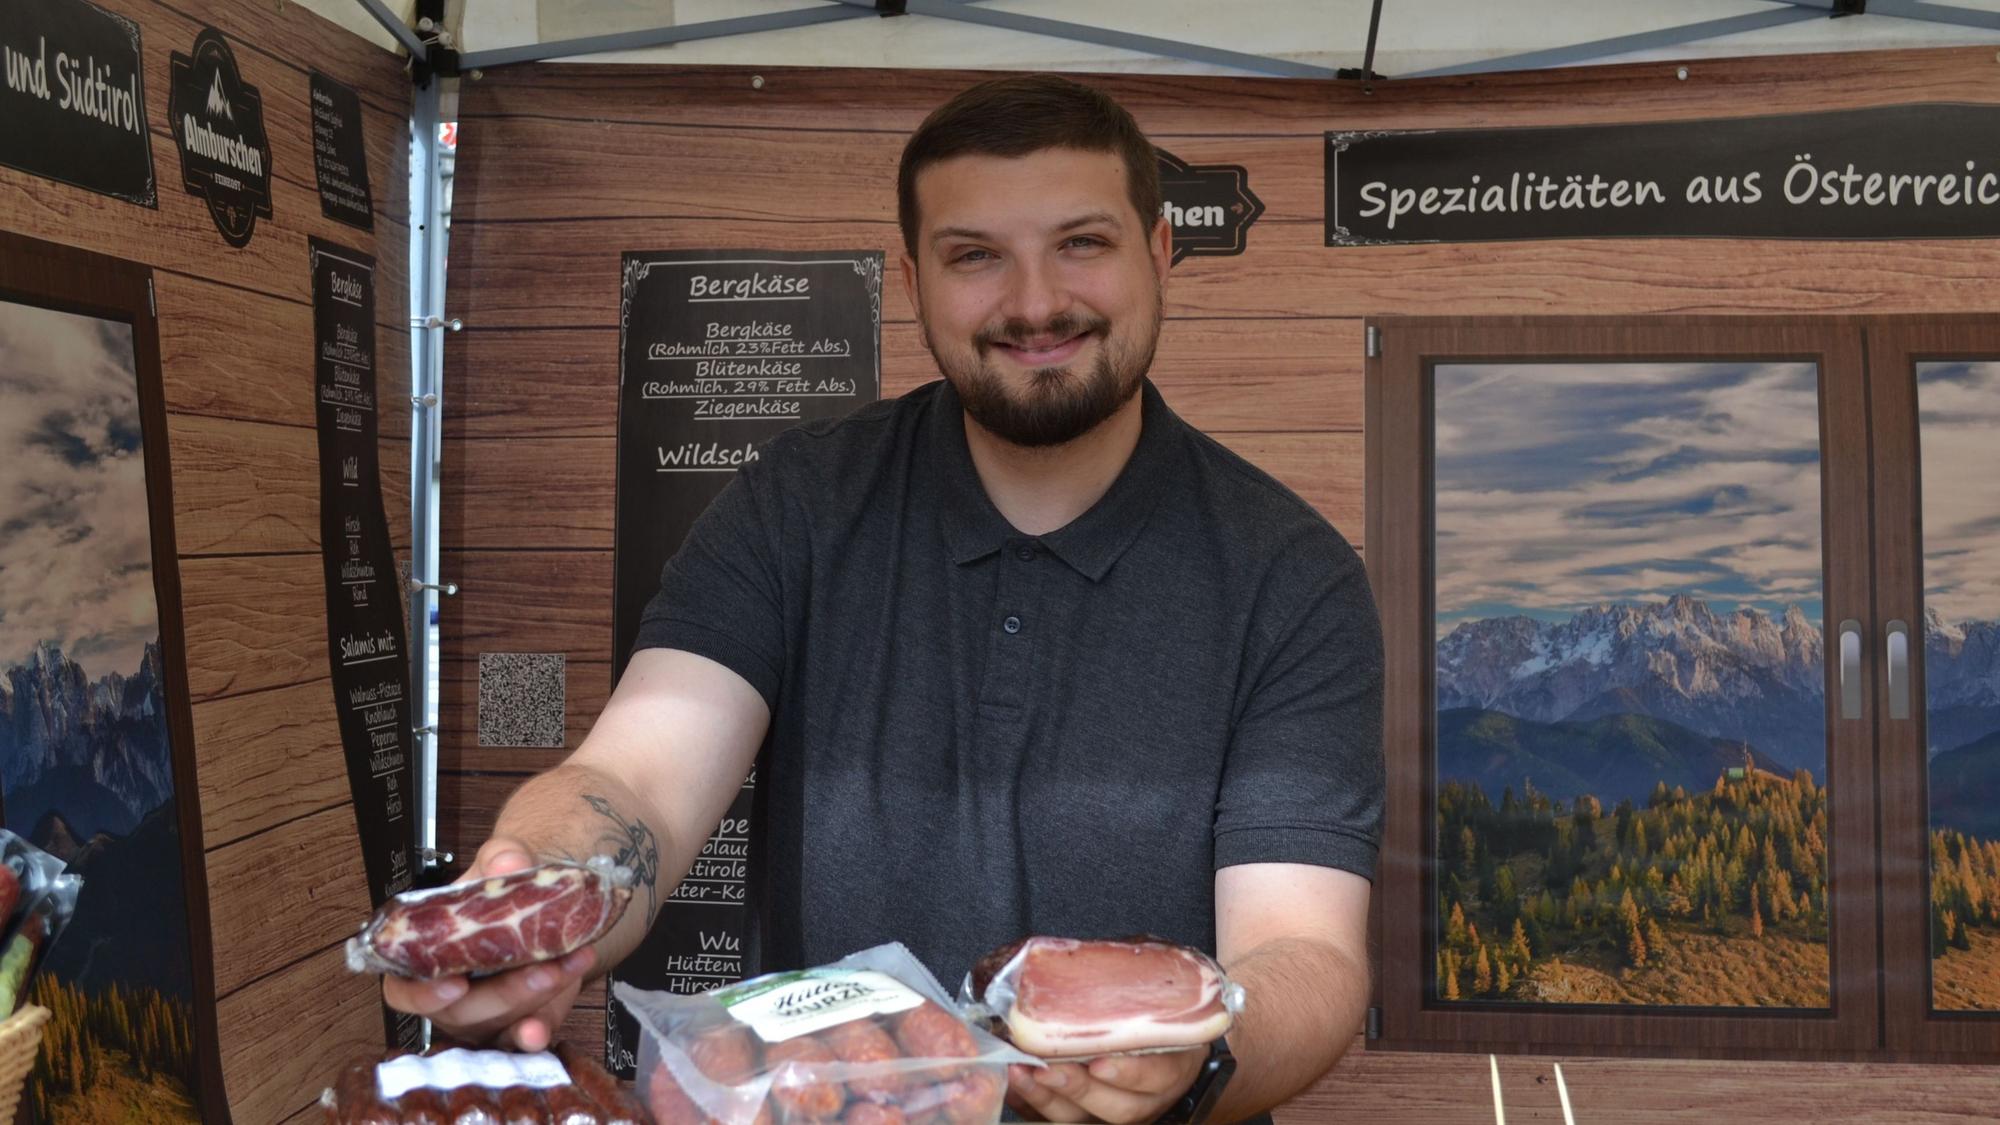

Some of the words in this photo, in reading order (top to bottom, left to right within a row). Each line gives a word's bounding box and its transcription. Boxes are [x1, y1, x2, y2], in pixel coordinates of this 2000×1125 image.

[5, 36, 51, 100] und
[56, 52, 140, 135] Südtirol
[184, 112, 263, 177] Almburschen
[1359, 171, 1666, 230] Spezialitäten
[1686, 171, 1762, 204] aus
[1783, 153, 2000, 206] Österreic
[1158, 201, 1225, 227] hen
[331, 271, 362, 301] Bergkäse
[690, 272, 810, 299] Bergkäse
[706, 321, 793, 341] Bergkäse
[648, 341, 730, 358] (Rohmilch
[810, 338, 850, 356] Abs.)
[695, 359, 802, 377] Blütenkäse
[642, 380, 728, 398] (Rohmilch,
[734, 381, 769, 393] 29%
[776, 380, 811, 392] Fett
[815, 377, 856, 395] Abs.)
[694, 398, 801, 417] Ziegenkäse
[657, 442, 760, 466] Wildsch
[342, 456, 358, 480] Wild
[340, 631, 376, 659] Salamis
[666, 955, 742, 974] Hütten
